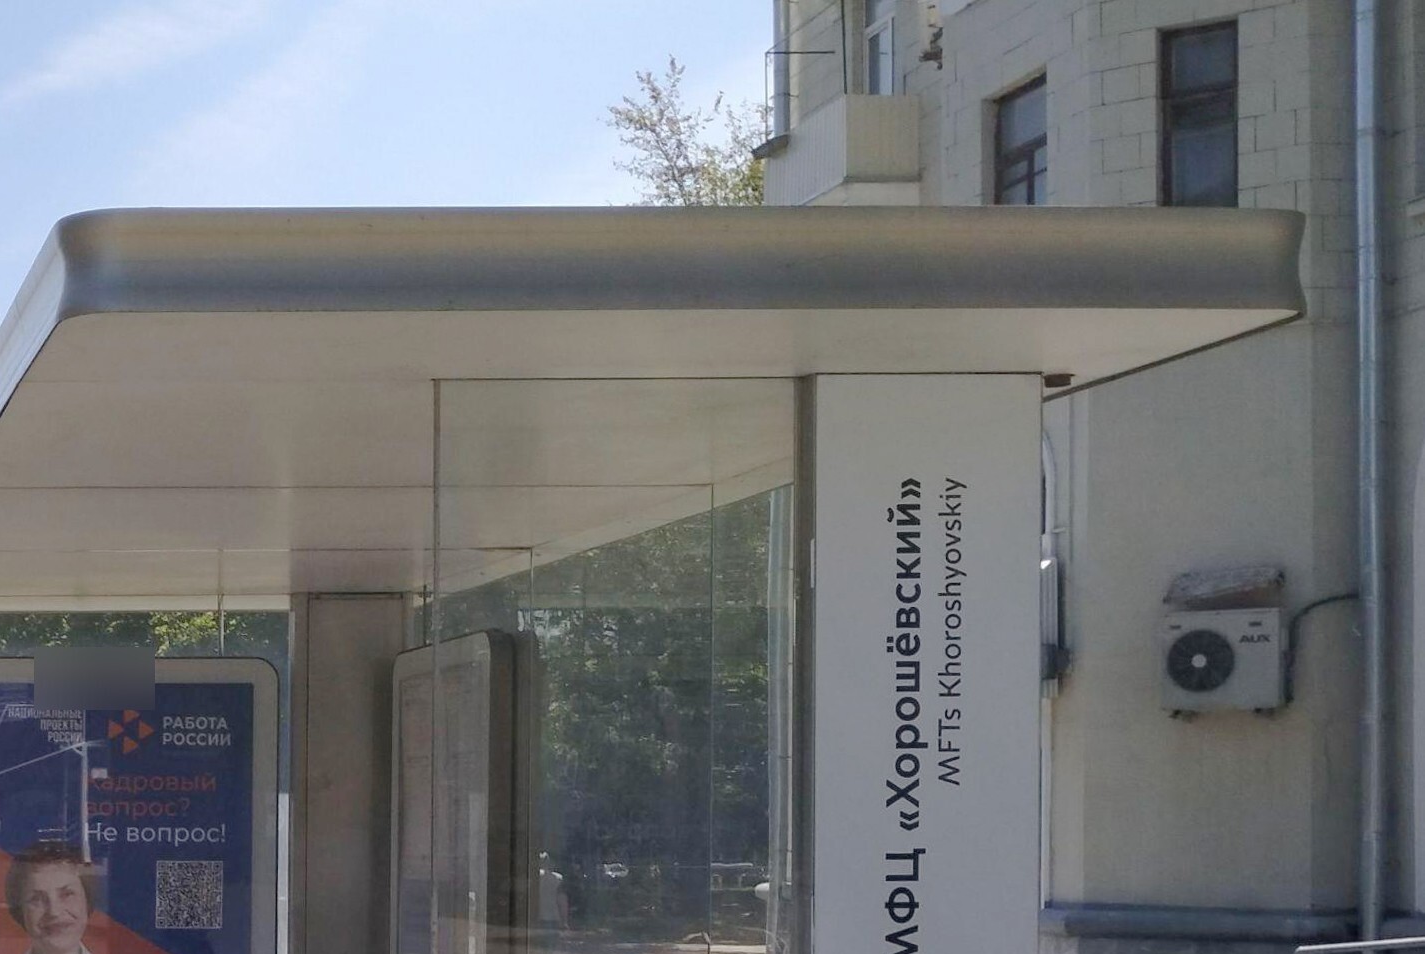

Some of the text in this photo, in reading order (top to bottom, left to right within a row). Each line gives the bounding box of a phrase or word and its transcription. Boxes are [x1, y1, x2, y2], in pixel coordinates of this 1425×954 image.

[937, 476, 968, 786] MFTs Khoroshyovskiy
[1238, 634, 1271, 644] AUX
[885, 477, 928, 831] «Хорошёвский»
[40, 719, 83, 731] ПРОЕКТЫ
[162, 716, 229, 730] РАБОТА
[47, 731, 83, 743] РОССИИ
[162, 732, 232, 746] РОССИИ
[87, 797, 191, 820] вопрос?
[85, 822, 226, 847] Не вопрос!
